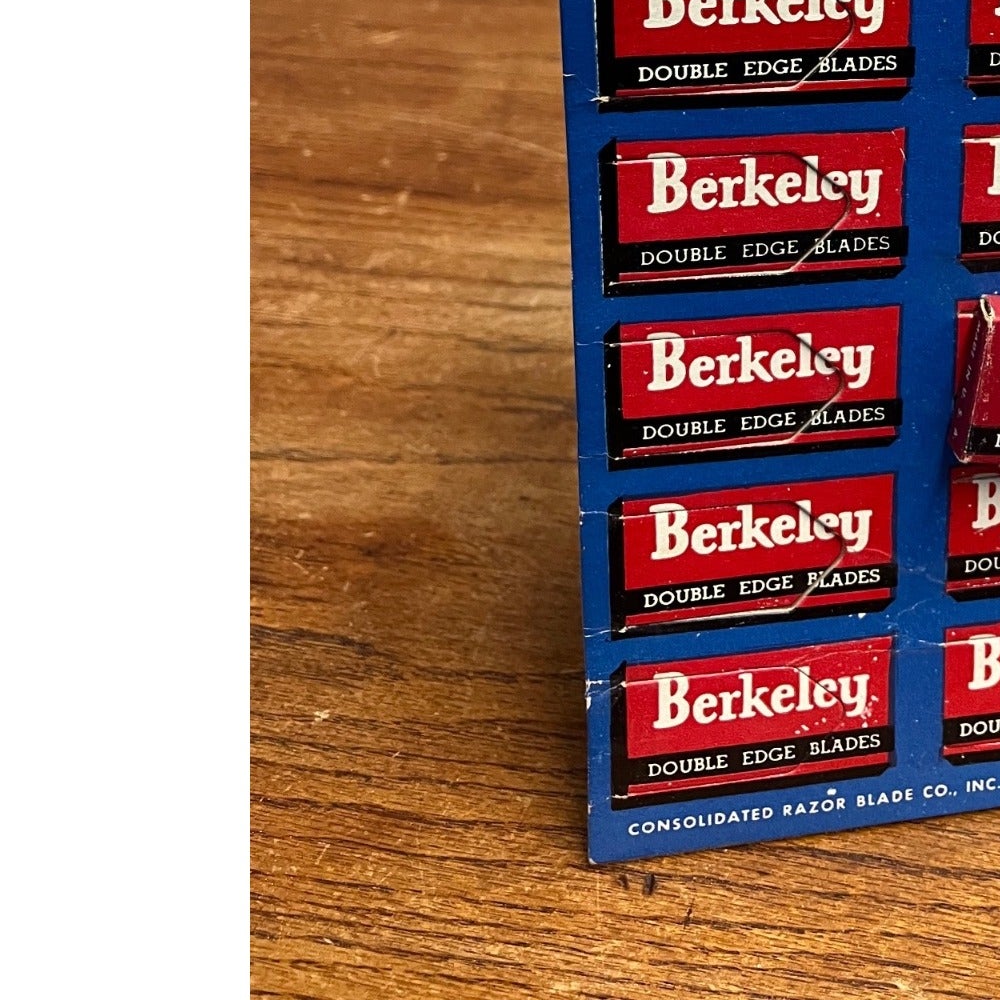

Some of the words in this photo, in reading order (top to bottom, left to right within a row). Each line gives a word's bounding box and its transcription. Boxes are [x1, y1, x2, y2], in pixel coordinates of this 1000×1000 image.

[638, 62, 728, 83] DOUBLE
[743, 58, 803, 77] EDGE
[818, 55, 898, 74] BLADES
[647, 152, 883, 215] Berkeley
[641, 245, 727, 266] DOUBLE
[742, 240, 799, 259] EDGE
[815, 236, 891, 255] BLADES
[647, 332, 875, 391] Berkeley
[642, 419, 726, 440] DOUBLE
[741, 412, 796, 431] EDGE
[811, 407, 886, 426] BLADES
[649, 500, 873, 560] Berkeley
[643, 584, 725, 608] DOUBLE
[739, 575, 793, 596] EDGE
[807, 569, 881, 588] BLADES
[652, 666, 870, 729] Berkeley
[648, 754, 728, 777] DOUBLE
[742, 745, 796, 766] EDGE
[810, 734, 881, 756] BLADES
[628, 806, 774, 836] CONSOLIDATED
[782, 798, 846, 816] RAZOR
[856, 788, 914, 807] BLADE
[922, 784, 958, 798] CO.,
